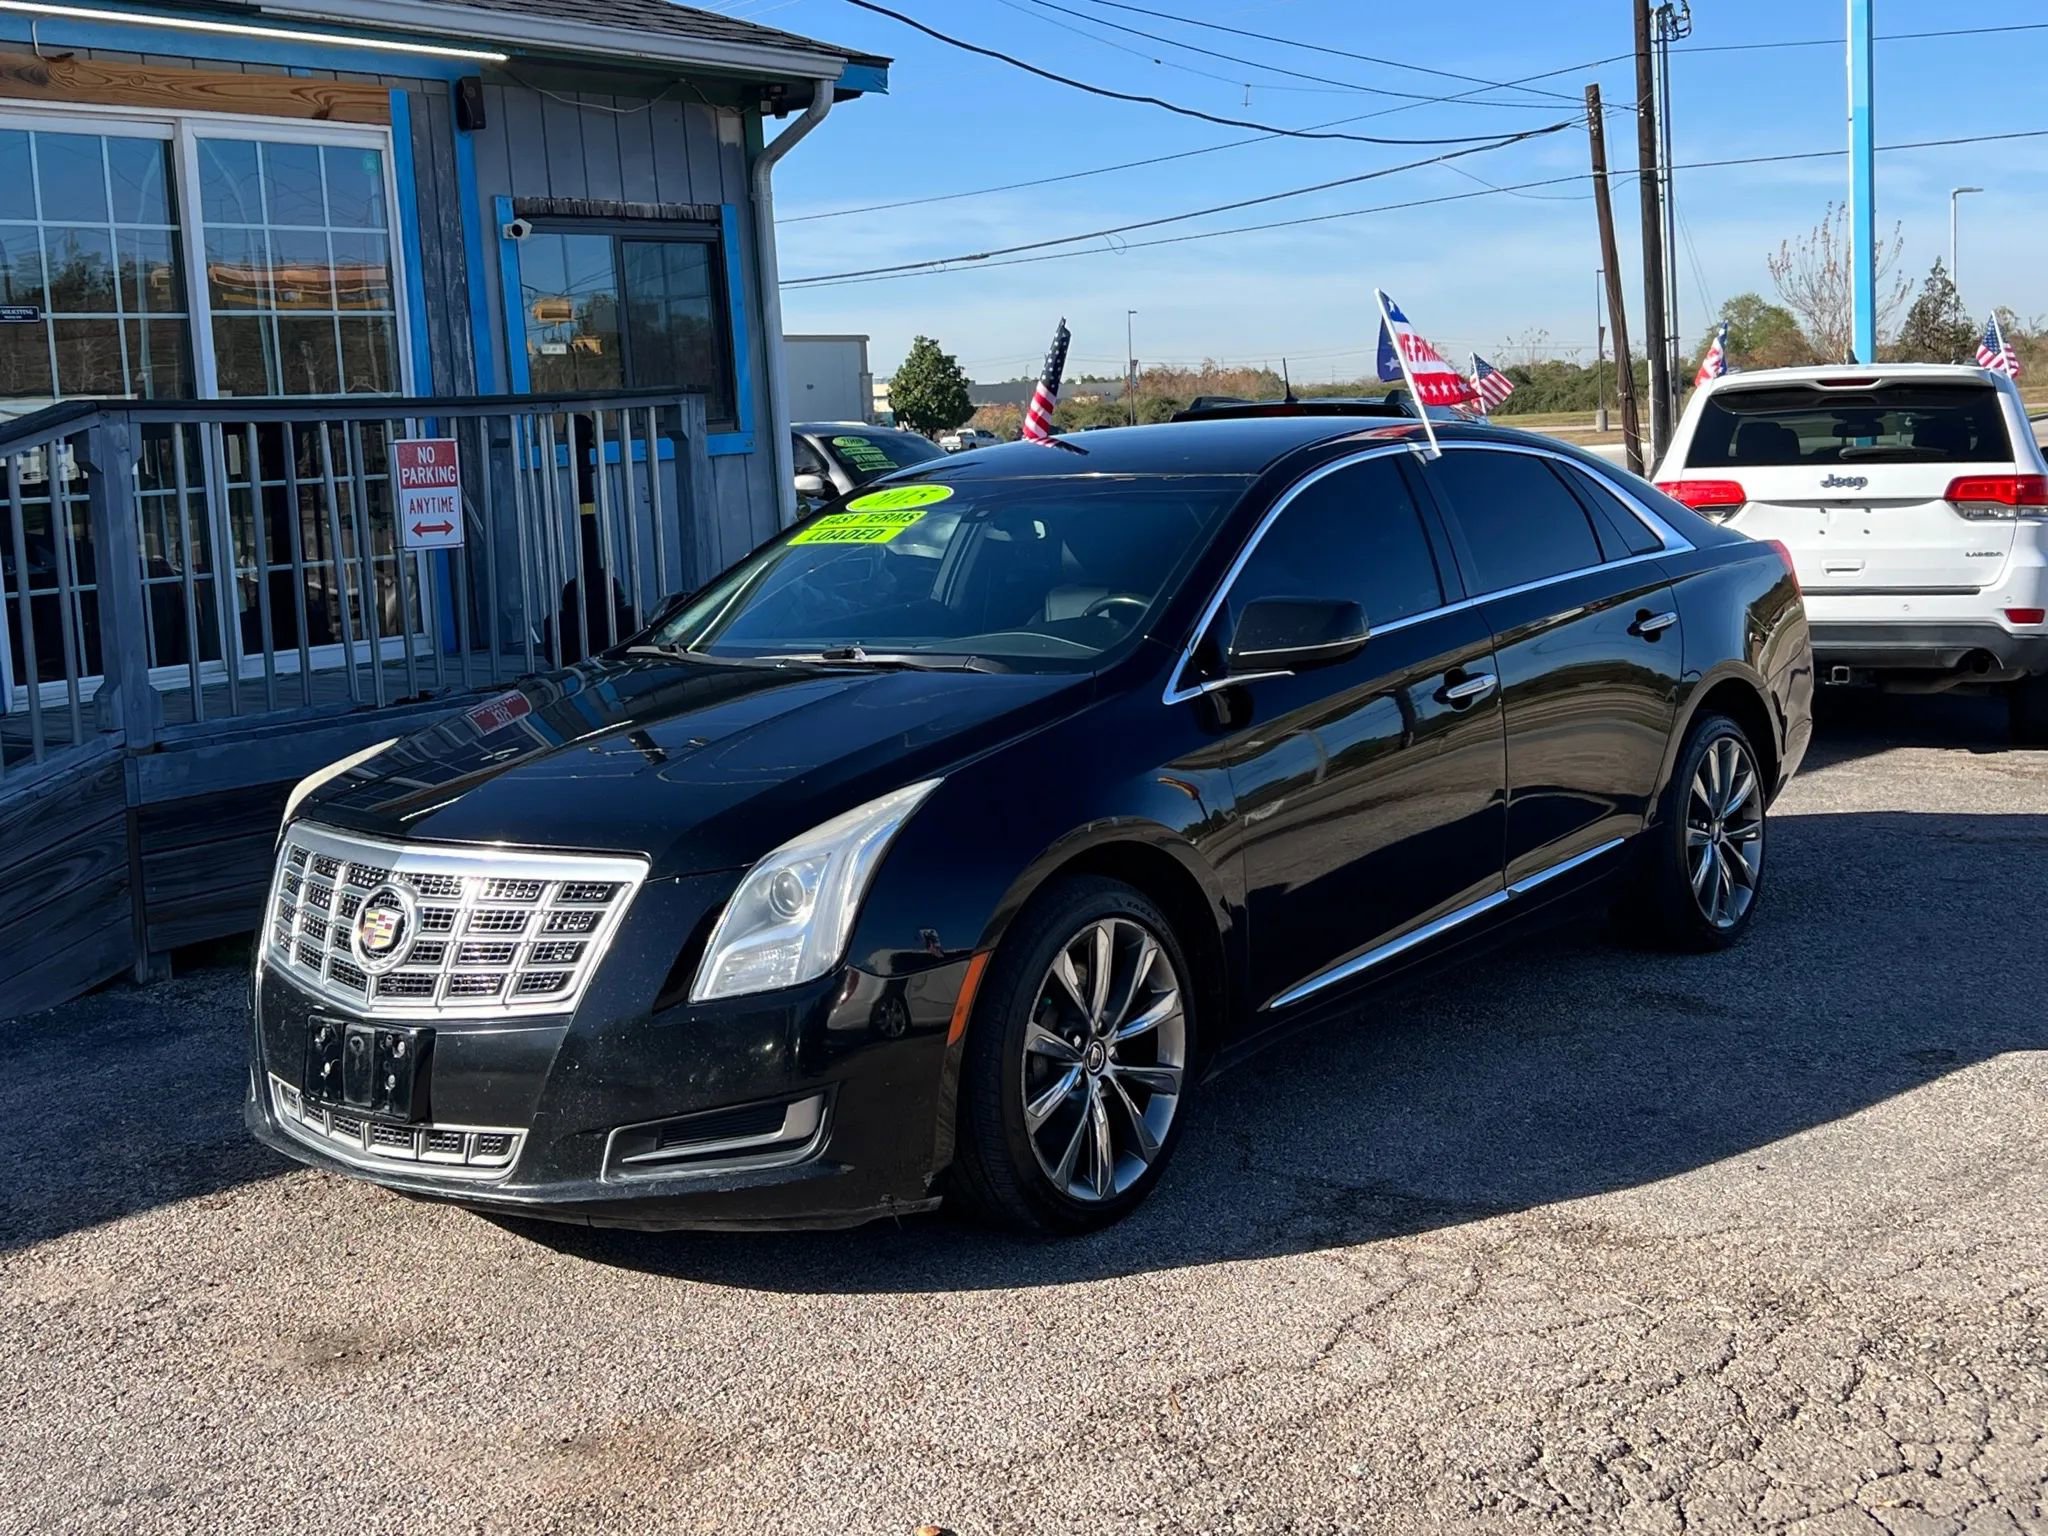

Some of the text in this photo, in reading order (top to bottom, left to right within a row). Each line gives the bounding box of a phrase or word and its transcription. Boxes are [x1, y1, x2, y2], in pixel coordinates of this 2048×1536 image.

[417, 446, 435, 464] NO
[401, 465, 456, 485] PARKING
[1820, 473, 1869, 491] Jeep
[409, 496, 455, 515] ANYTIME
[863, 511, 922, 524] TERMS
[805, 528, 887, 542] LOADED
